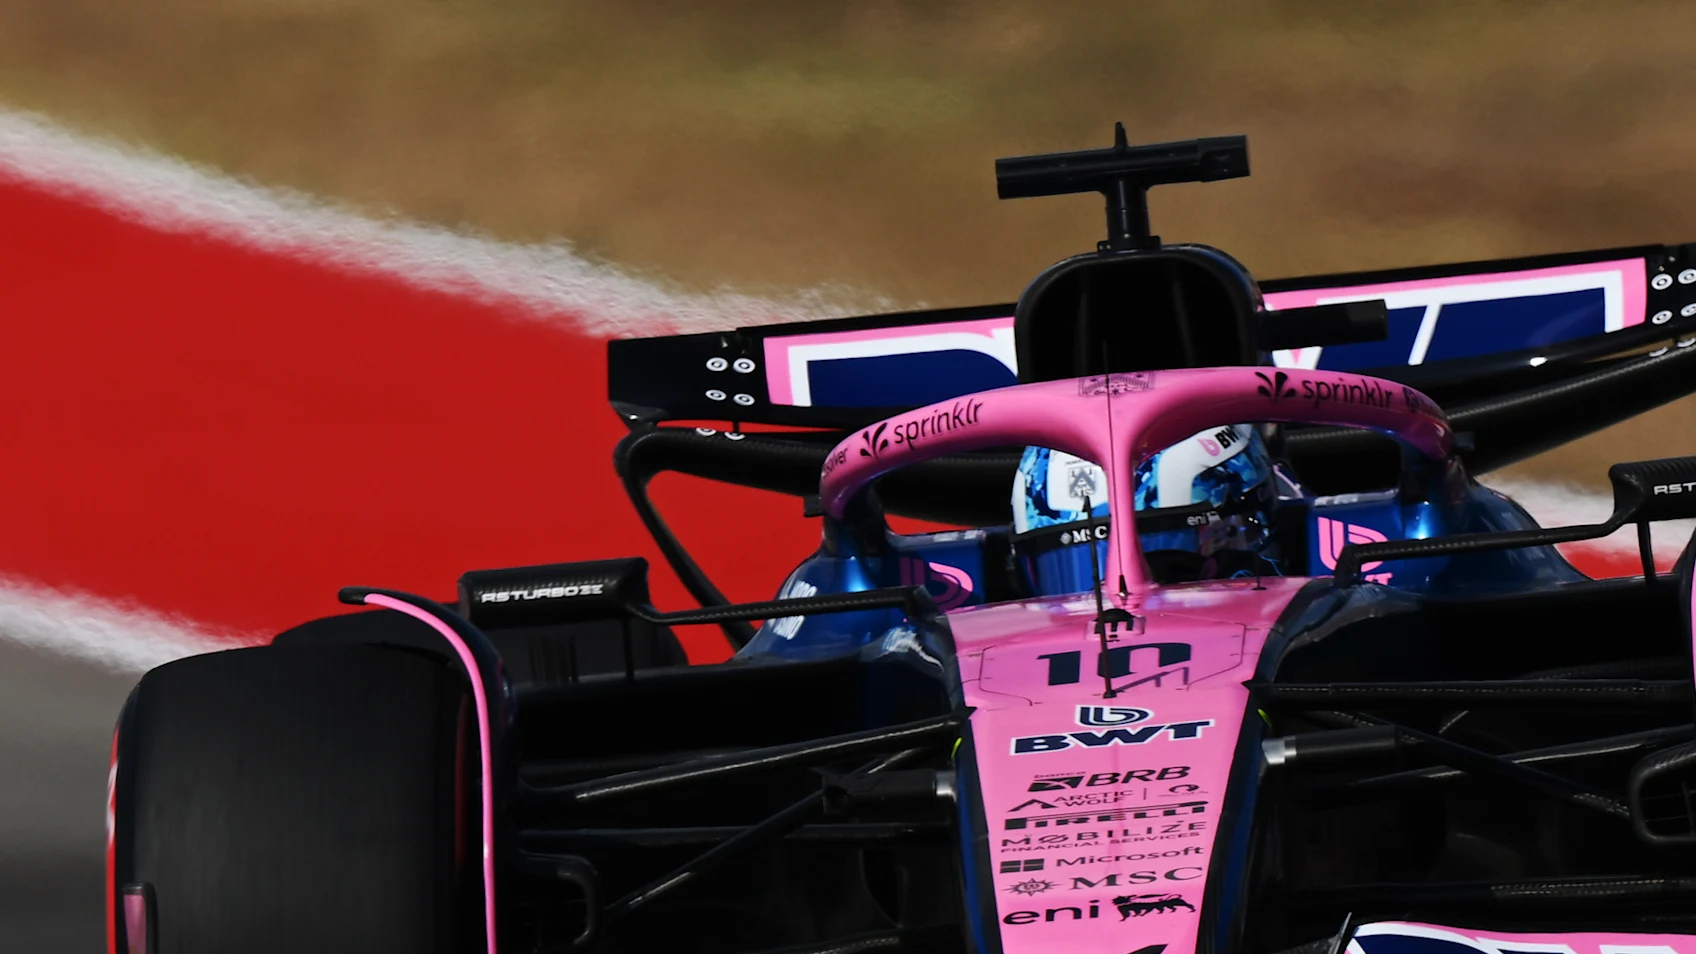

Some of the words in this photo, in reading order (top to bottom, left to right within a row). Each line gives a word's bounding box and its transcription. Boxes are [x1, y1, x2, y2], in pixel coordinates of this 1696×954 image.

[1301, 377, 1394, 410] sprinklr
[894, 397, 983, 450] sprinklr
[1009, 719, 1215, 756] BWT
[1086, 766, 1191, 787] BRB
[1053, 789, 1133, 803] ARCTIC
[1063, 797, 1126, 807] WOLF
[1004, 800, 1209, 831] PIRELLI
[1000, 840, 1105, 854] FINANCIAL
[1109, 831, 1201, 845] SERVICES
[1056, 846, 1204, 868] Microsoft
[1068, 867, 1203, 891] MSC
[1002, 900, 1100, 925] eni
